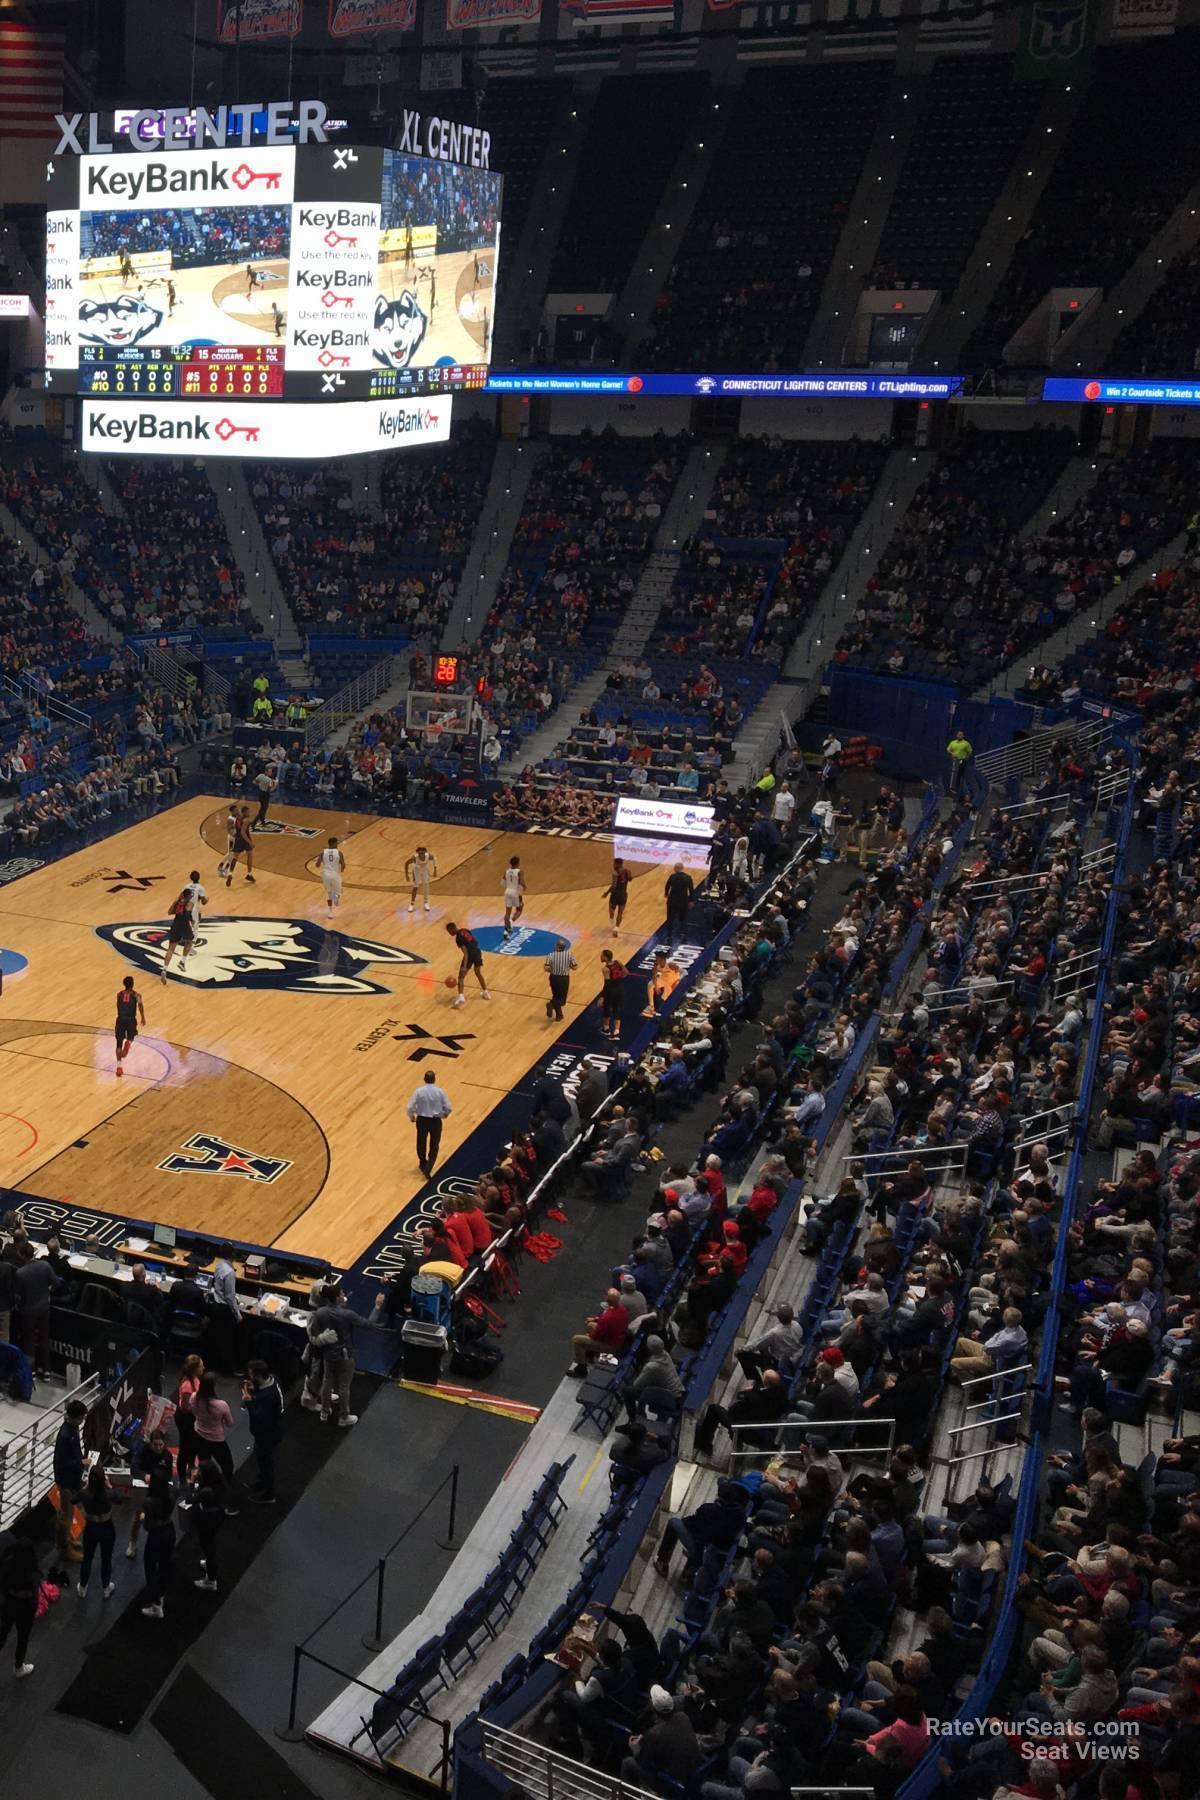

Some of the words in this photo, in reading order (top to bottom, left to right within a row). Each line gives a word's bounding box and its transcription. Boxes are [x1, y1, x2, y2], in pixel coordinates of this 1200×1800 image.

[54, 112, 113, 155] XL
[129, 99, 329, 151] CENTER
[400, 109, 422, 154] XL
[428, 116, 491, 169] CENTER
[333, 149, 359, 170] XL
[88, 160, 230, 201] KeyBank
[299, 209, 377, 228] KeyBank
[47, 217, 73, 234] Bank
[301, 251, 320, 260] Use
[324, 251, 339, 260] the
[343, 251, 359, 260] red
[47, 274, 73, 290] Bank
[296, 270, 373, 289] KeyBank
[299, 311, 317, 319] Use
[321, 311, 337, 319] the
[340, 311, 355, 319] red
[46, 331, 72, 345] Bank
[293, 330, 370, 349] KeyBank
[150, 349, 161, 359] 15
[198, 350, 208, 360] 15
[211, 353, 244, 361] COUGARS
[94, 371, 108, 381] #0
[117, 371, 124, 381] 0
[132, 371, 140, 381] 0
[149, 371, 156, 381] 0
[163, 371, 171, 381] 0
[186, 372, 200, 381] #5
[210, 372, 218, 381] 0
[228, 372, 233, 381] 1
[243, 372, 251, 381] 0
[259, 372, 267, 381] 0
[91, 382, 109, 392] #10
[116, 382, 124, 392] 0
[134, 382, 138, 392] 1
[148, 382, 156, 392] 0
[163, 382, 171, 392] 0
[185, 383, 200, 393] #11
[210, 383, 217, 393] 0
[226, 383, 234, 393] 0
[243, 383, 251, 393] 0
[259, 383, 267, 393] 0
[321, 374, 346, 392] XL
[489, 380, 512, 388] Tickets
[514, 380, 521, 388] to
[522, 380, 533, 388] the
[534, 380, 549, 388] Next
[550, 380, 580, 388] Women's
[581, 381, 599, 389] Home
[602, 381, 623, 389] Game!
[722, 380, 782, 390] CONNECTICUT
[784, 381, 824, 391] LIGHTING
[826, 381, 867, 391] CENTERS
[879, 382, 948, 393] CTLighting.com
[1106, 388, 1121, 396] Win
[1122, 388, 1127, 396] 2
[1128, 388, 1164, 397] Courtside
[1165, 389, 1189, 398] Tickets
[90, 413, 210, 443] KeyBank
[379, 408, 423, 439] KeyBank
[439, 657, 457, 666] 10:32
[437, 666, 455, 680] 28
[445, 794, 488, 806] TRAVELERS
[620, 807, 654, 817] KeyBank
[329, 854, 334, 862] 0
[381, 1018, 400, 1028] XL
[352, 1027, 391, 1052] CENTER
[546, 1053, 576, 1080] HEAL
